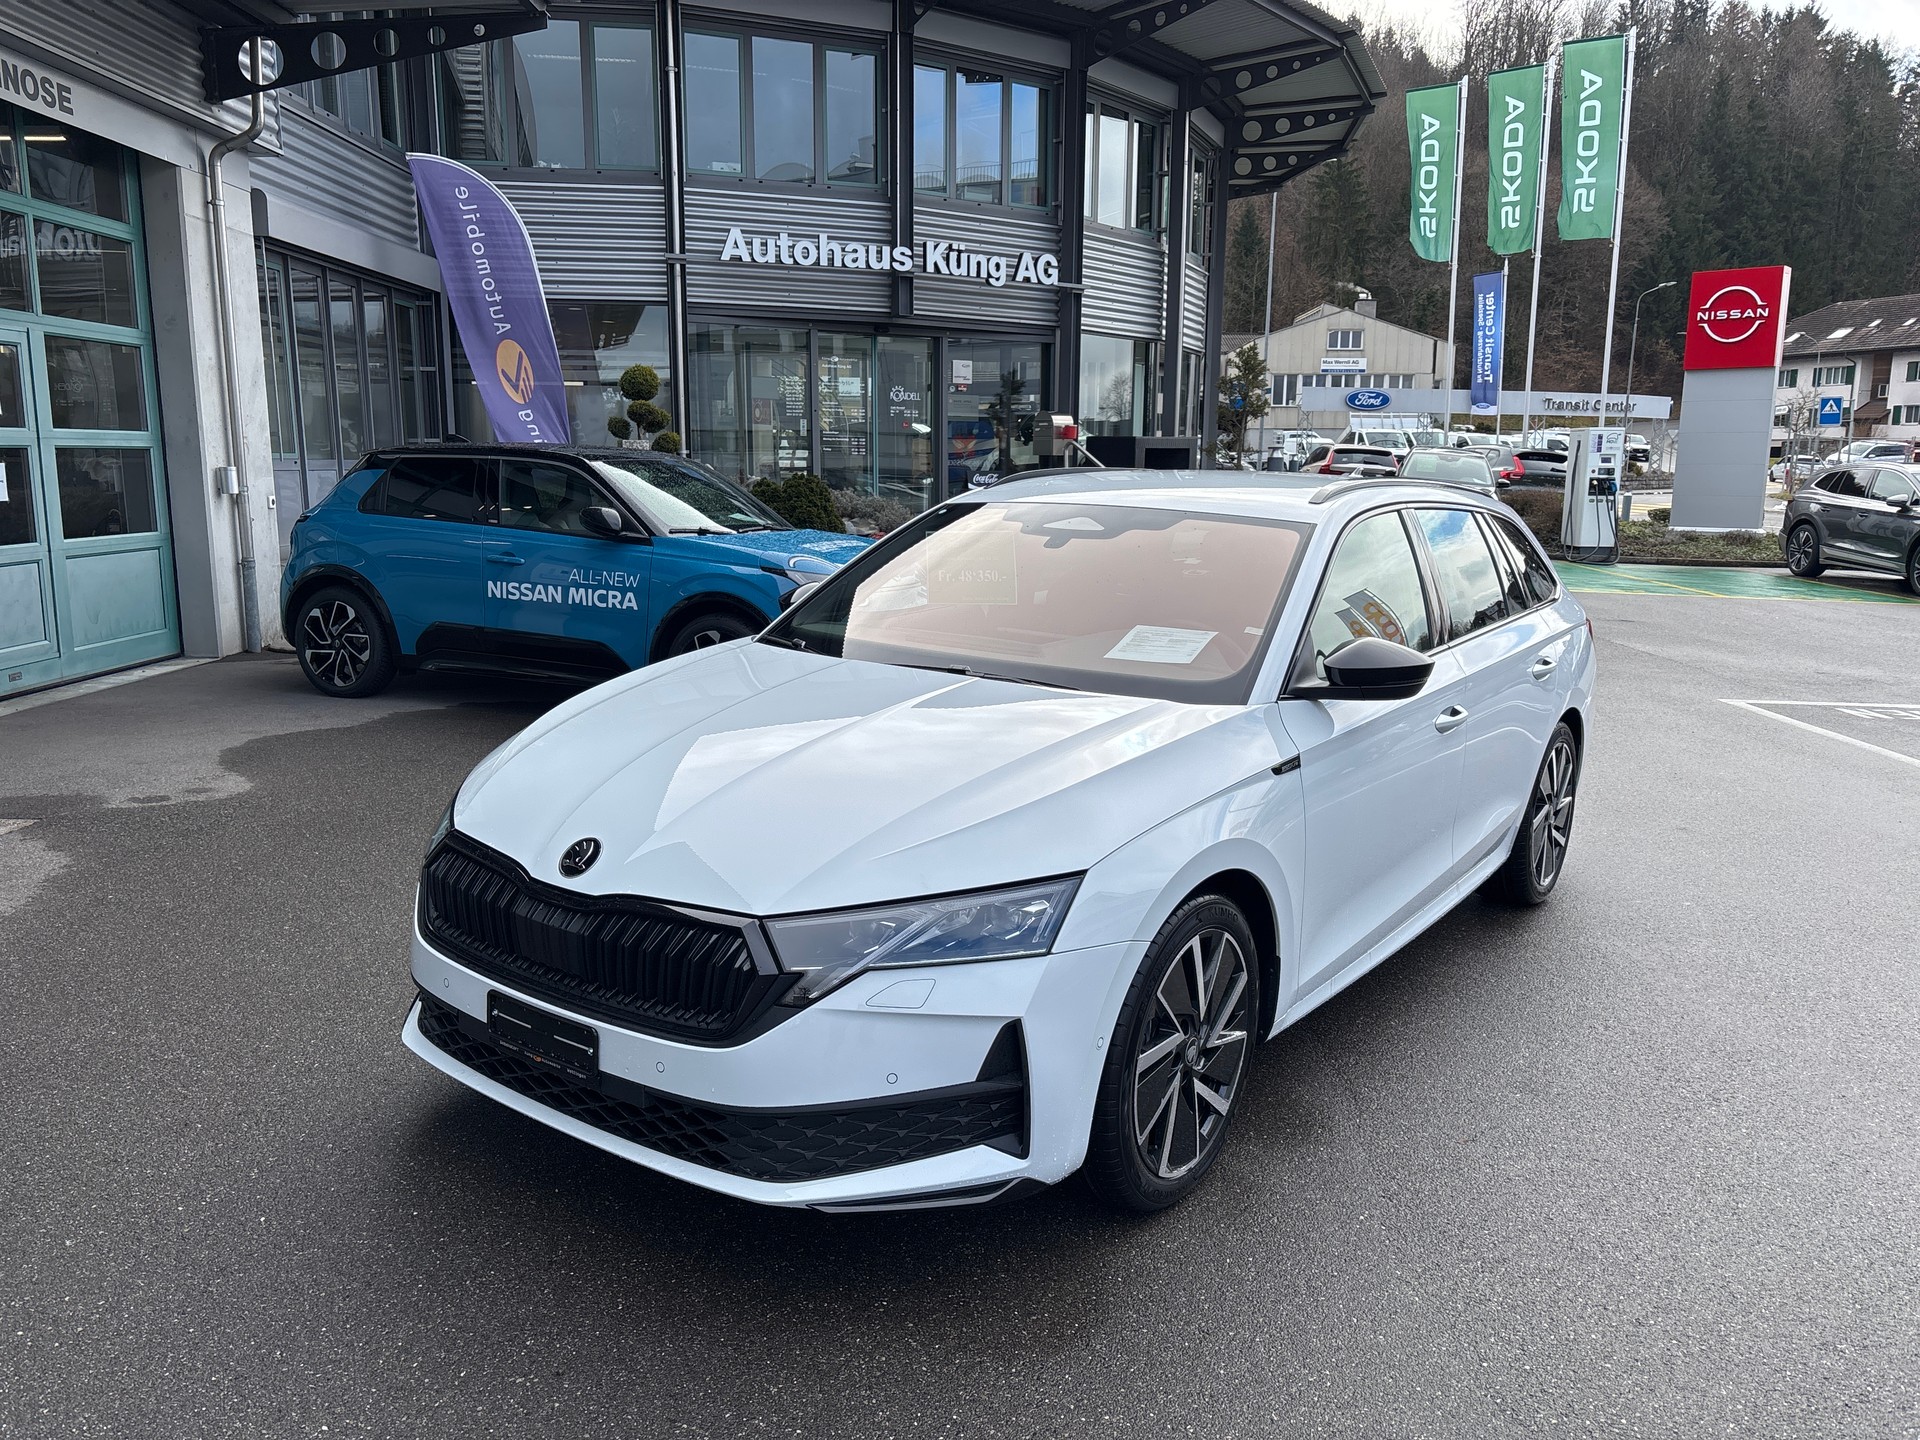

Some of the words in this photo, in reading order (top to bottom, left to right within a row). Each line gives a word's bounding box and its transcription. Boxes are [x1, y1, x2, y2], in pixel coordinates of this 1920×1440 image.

[0, 58, 74, 116] NOSE
[720, 227, 913, 271] Autohaus
[926, 240, 1007, 287] Küng
[1015, 252, 1059, 285] AG
[1697, 307, 1769, 321] NISSAN
[1355, 392, 1383, 406] Ford
[1544, 398, 1589, 411] Transit
[568, 568, 640, 588] ALL-NEW
[938, 570, 955, 582] Fr.
[487, 580, 562, 604] NISSAN
[568, 587, 639, 611] MICRA
